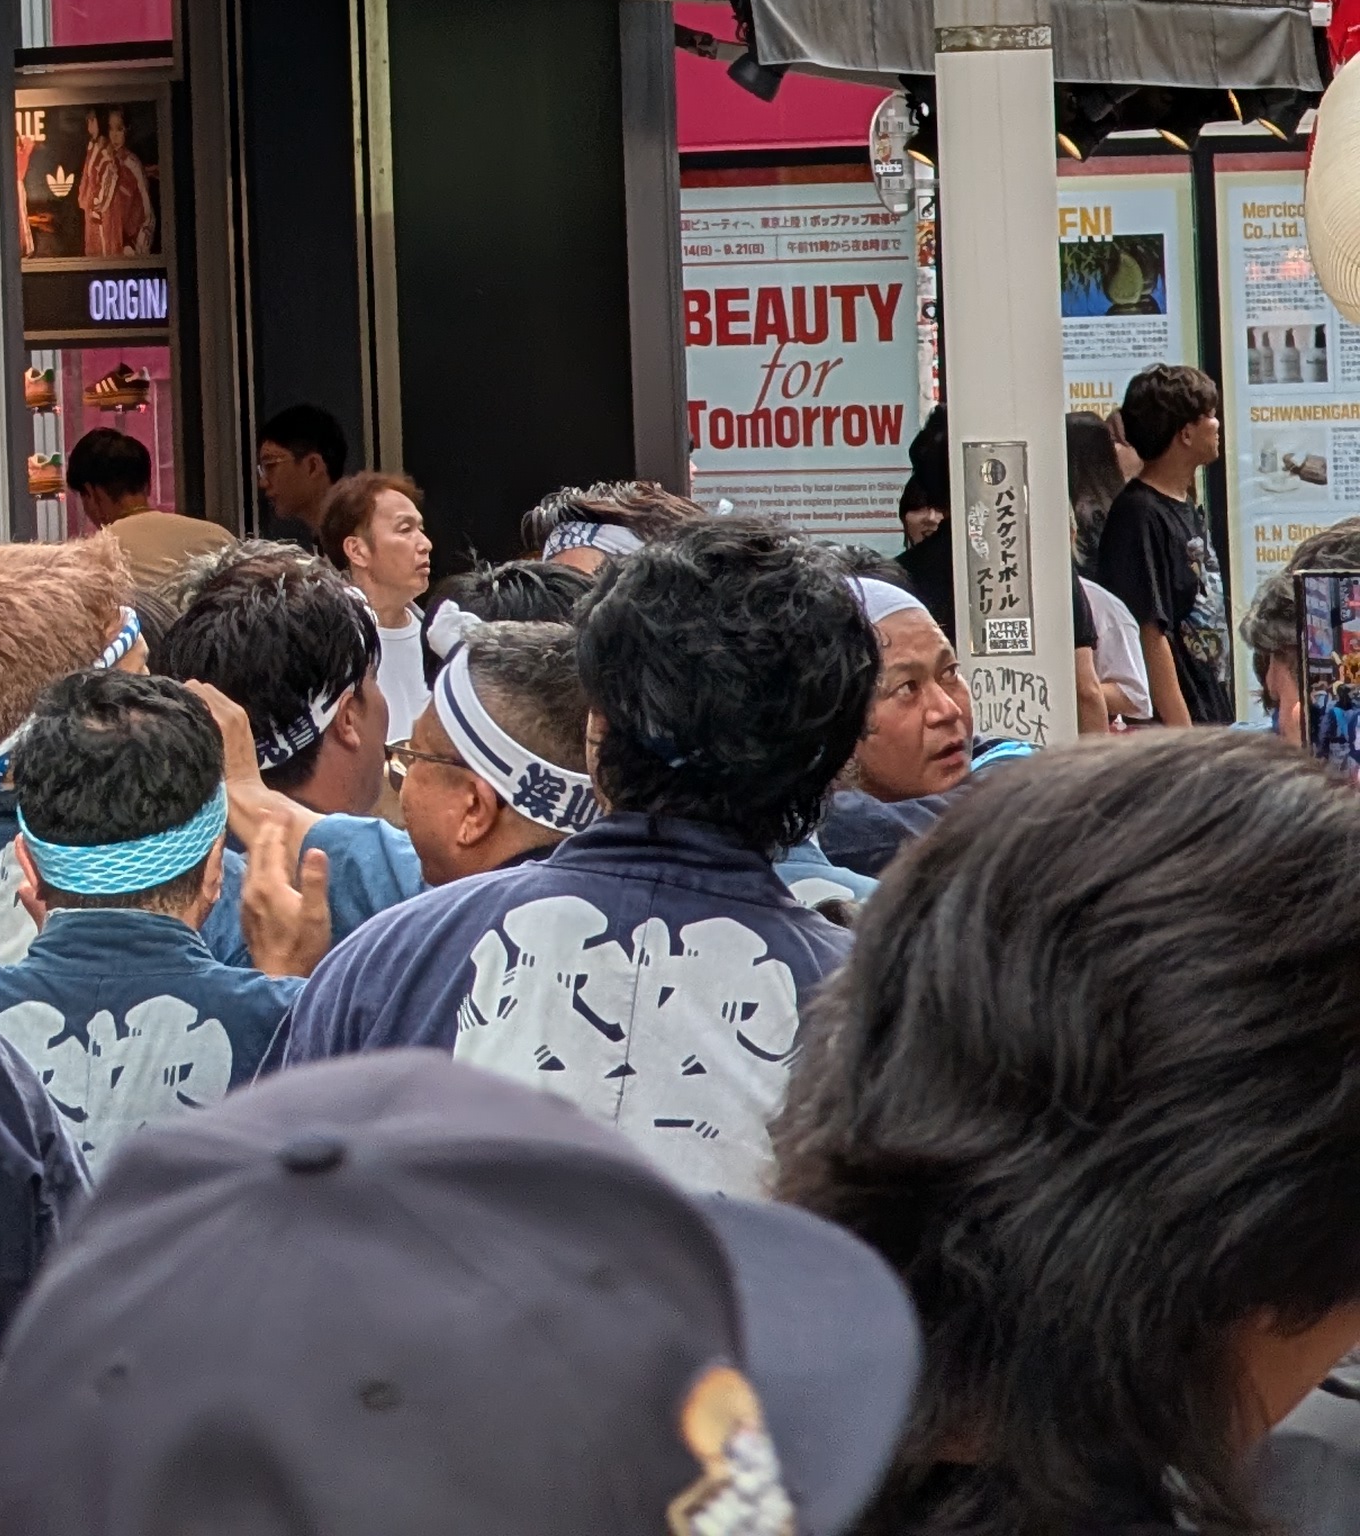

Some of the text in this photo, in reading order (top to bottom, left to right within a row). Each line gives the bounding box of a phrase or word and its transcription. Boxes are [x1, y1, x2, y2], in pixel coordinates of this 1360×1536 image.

[684, 283, 903, 347] BEAUTY
[746, 339, 844, 414] for
[687, 399, 904, 449] Tomorrow
[988, 620, 1028, 631] HYPER
[988, 630, 1029, 639] ACTIVE
